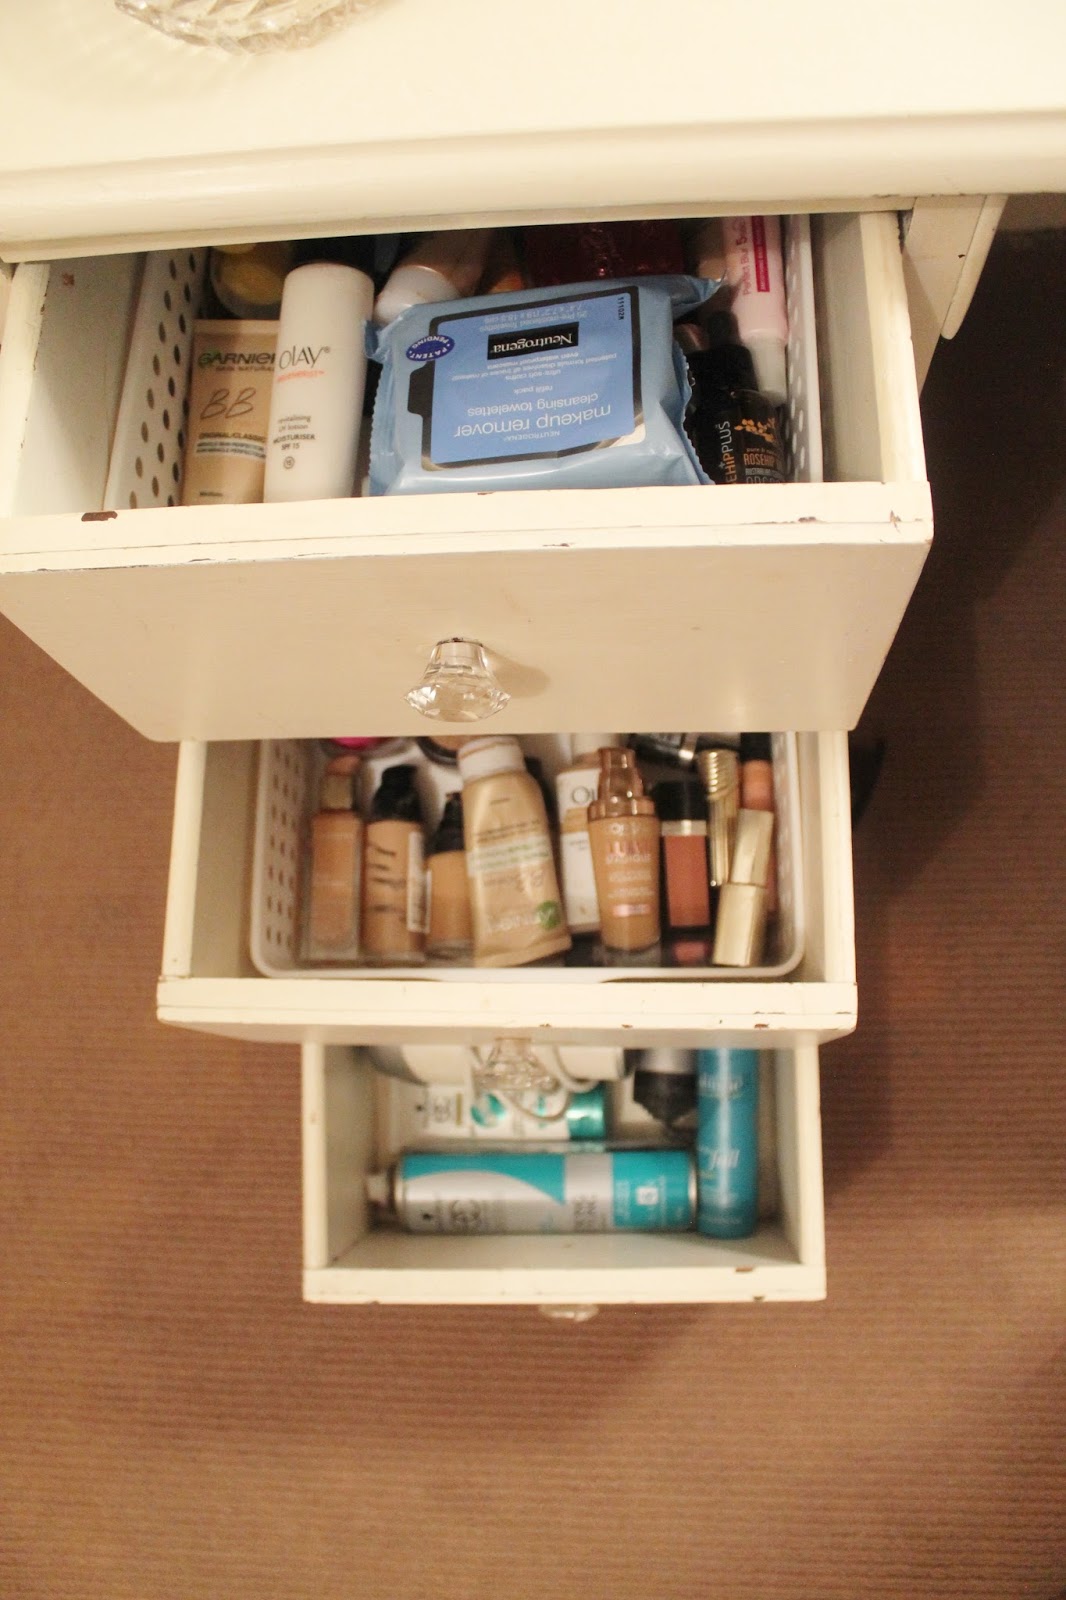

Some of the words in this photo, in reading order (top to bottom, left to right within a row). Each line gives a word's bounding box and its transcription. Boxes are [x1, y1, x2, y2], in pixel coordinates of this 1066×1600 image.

[411, 335, 449, 350] PENDING
[492, 333, 573, 354] Neutrogena
[409, 347, 447, 360] PATENT
[513, 386, 534, 396] pack
[536, 384, 554, 394] refill
[200, 386, 257, 421] BB
[467, 401, 532, 418] towelettes
[537, 392, 599, 411] cleansing
[536, 404, 611, 430] makeup
[454, 418, 530, 439] remover
[506, 430, 561, 442] NEUTROGENA
